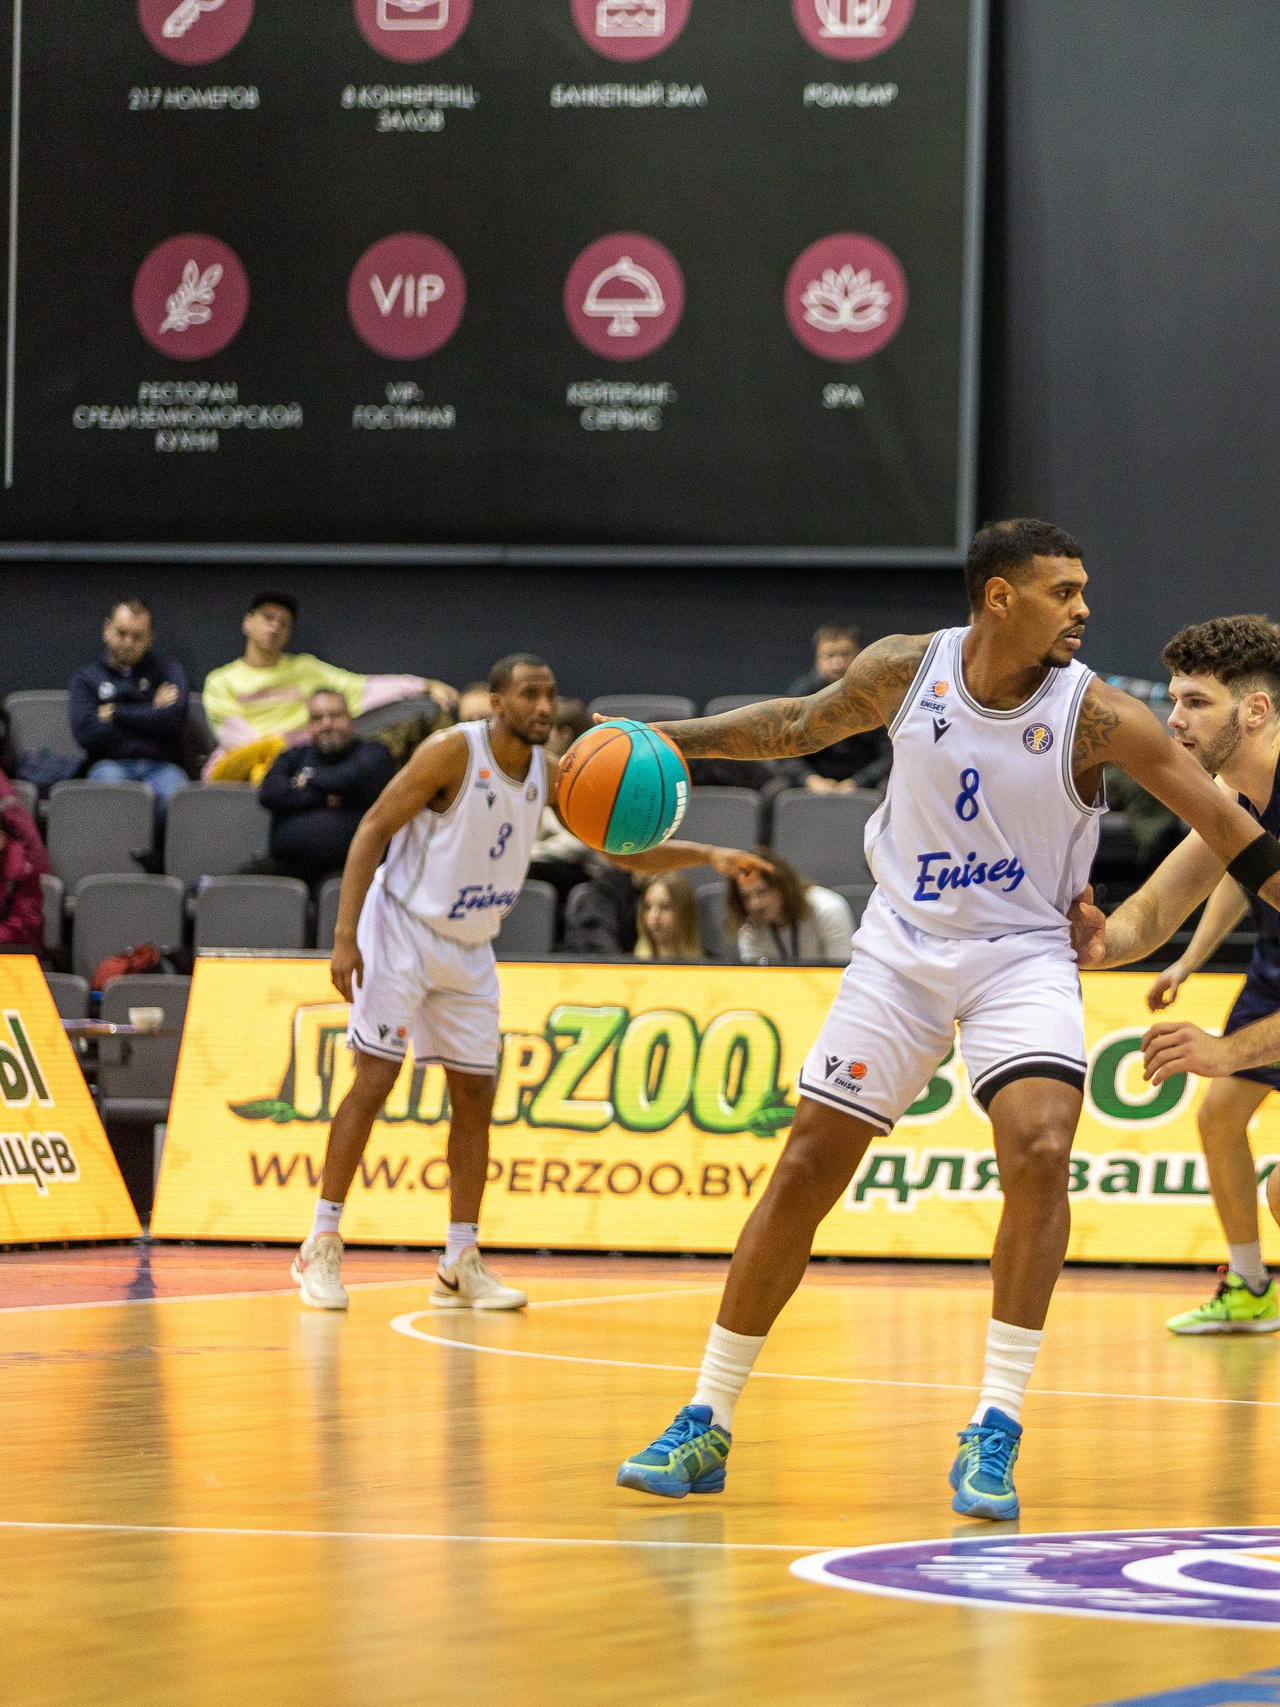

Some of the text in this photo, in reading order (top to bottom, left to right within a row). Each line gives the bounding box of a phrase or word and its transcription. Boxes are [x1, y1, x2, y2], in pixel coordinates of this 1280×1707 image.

[163, 84, 260, 110] НОМЕРОВ
[550, 80, 708, 108] БАНКЕТНЫЙ ЗАЛ
[375, 108, 445, 133] ЗАЛОВ
[369, 273, 445, 318] VIP
[138, 381, 238, 404] РЕСТОРАН
[72, 403, 303, 430] СРЕДИЗЕМНОМОРСКОЙ
[351, 404, 456, 430] ГОСТИНАЯ
[580, 405, 664, 431] СЕРВИС
[155, 429, 219, 452] КУХНИ
[920, 700, 947, 712] ENISEY
[955, 768, 979, 822] 8
[489, 822, 512, 860] 3
[913, 851, 1025, 902] Enisey
[834, 1077, 863, 1093] ENISEY
[854, 1155, 1002, 1203] для
